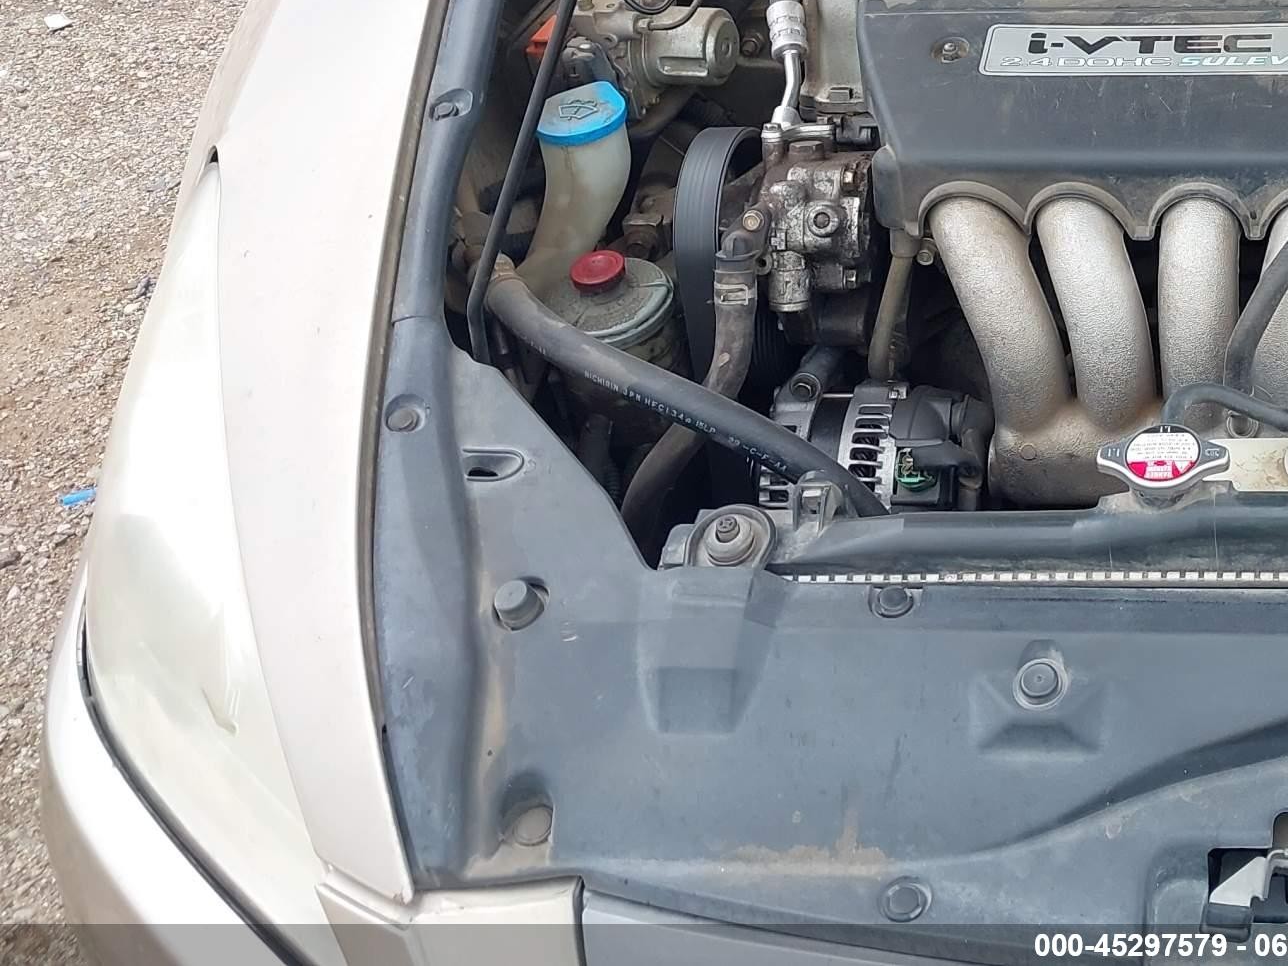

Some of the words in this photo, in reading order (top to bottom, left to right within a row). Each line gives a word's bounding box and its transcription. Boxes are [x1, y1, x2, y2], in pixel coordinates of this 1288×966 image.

[1027, 32, 1273, 55] i-VTEC
[1000, 56, 1053, 68] 2.4
[1057, 56, 1173, 68] DOHC
